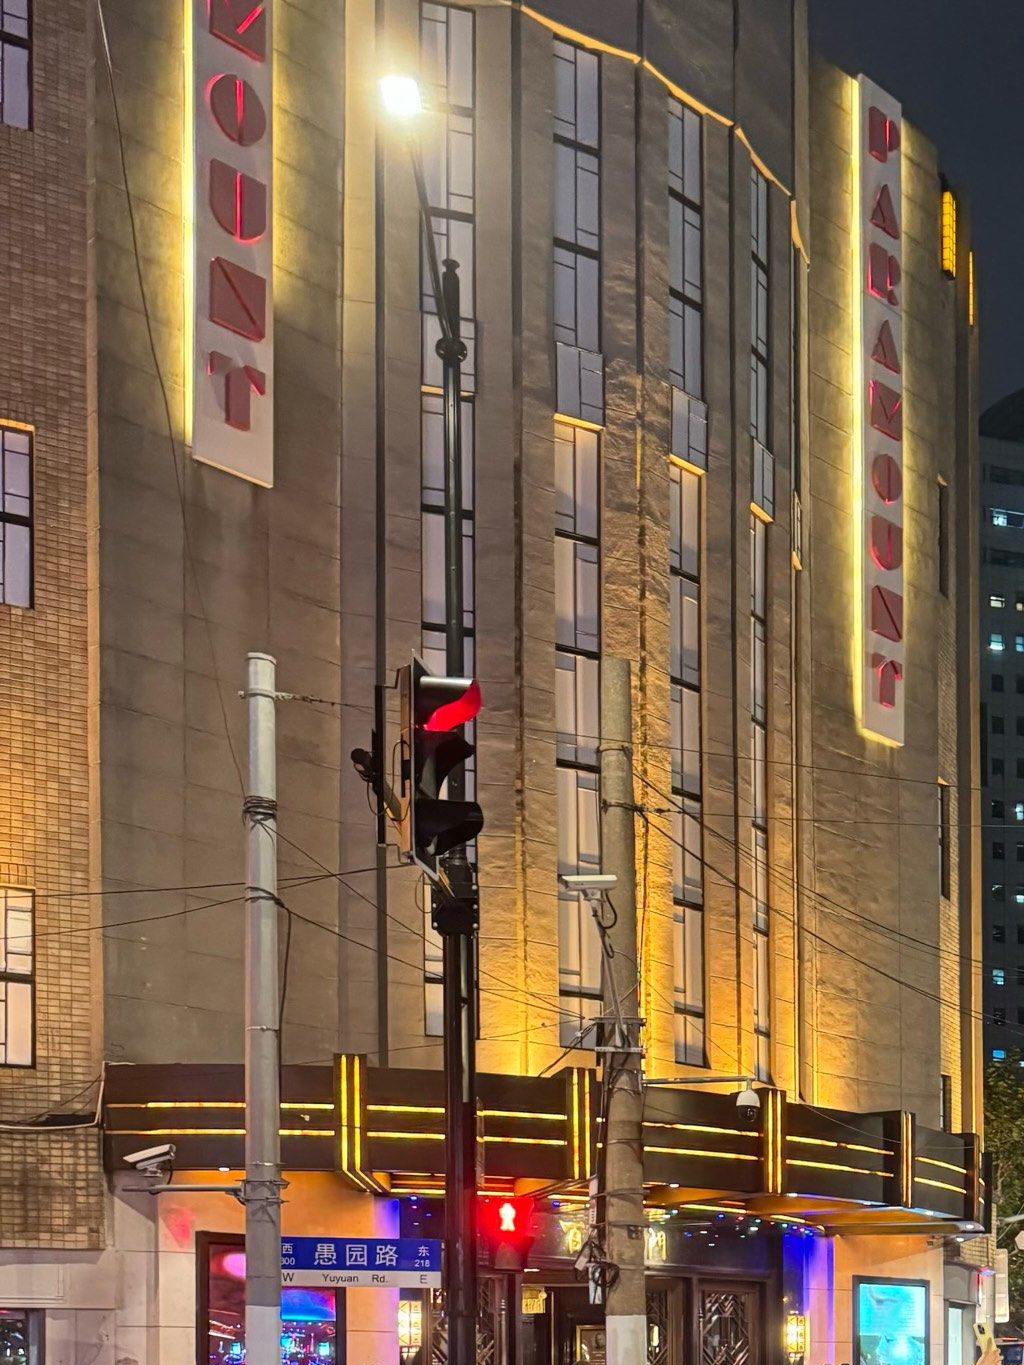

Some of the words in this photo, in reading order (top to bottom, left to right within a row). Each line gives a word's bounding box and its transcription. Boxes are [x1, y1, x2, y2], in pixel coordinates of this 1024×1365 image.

[868, 105, 904, 709] PARAMOUNT
[281, 1242, 294, 1255] 西
[314, 1243, 399, 1267] 愚园路
[418, 1245, 430, 1257] 东
[414, 1259, 431, 1268] 218
[282, 1272, 295, 1283] W
[322, 1273, 359, 1285] Yuyuan
[371, 1273, 389, 1283] Rd.
[419, 1274, 428, 1284] E
